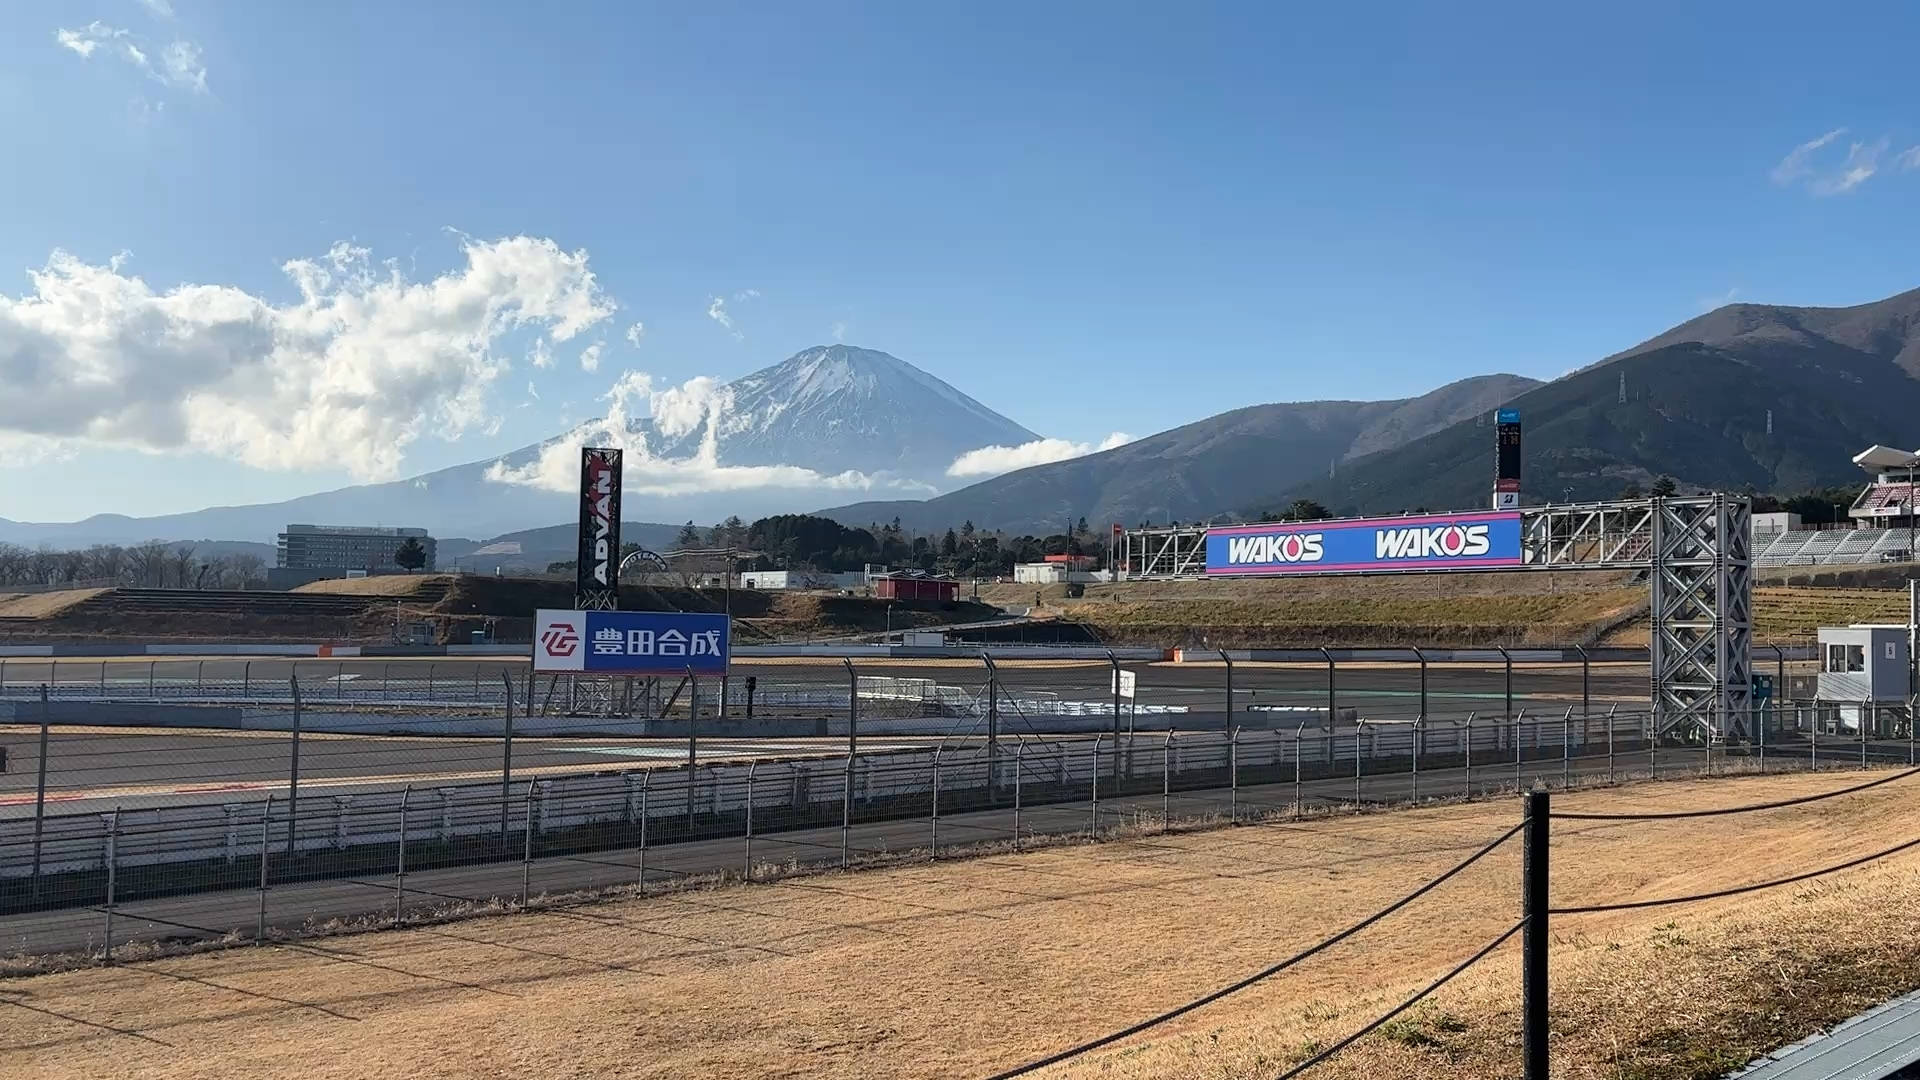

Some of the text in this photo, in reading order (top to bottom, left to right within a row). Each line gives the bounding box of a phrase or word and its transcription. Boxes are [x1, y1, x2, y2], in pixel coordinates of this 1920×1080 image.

[594, 469, 612, 586] ADVAN
[1376, 525, 1490, 559] WAKO'S
[1228, 534, 1324, 564] WAKO'S
[591, 627, 722, 657] 豊田合成
